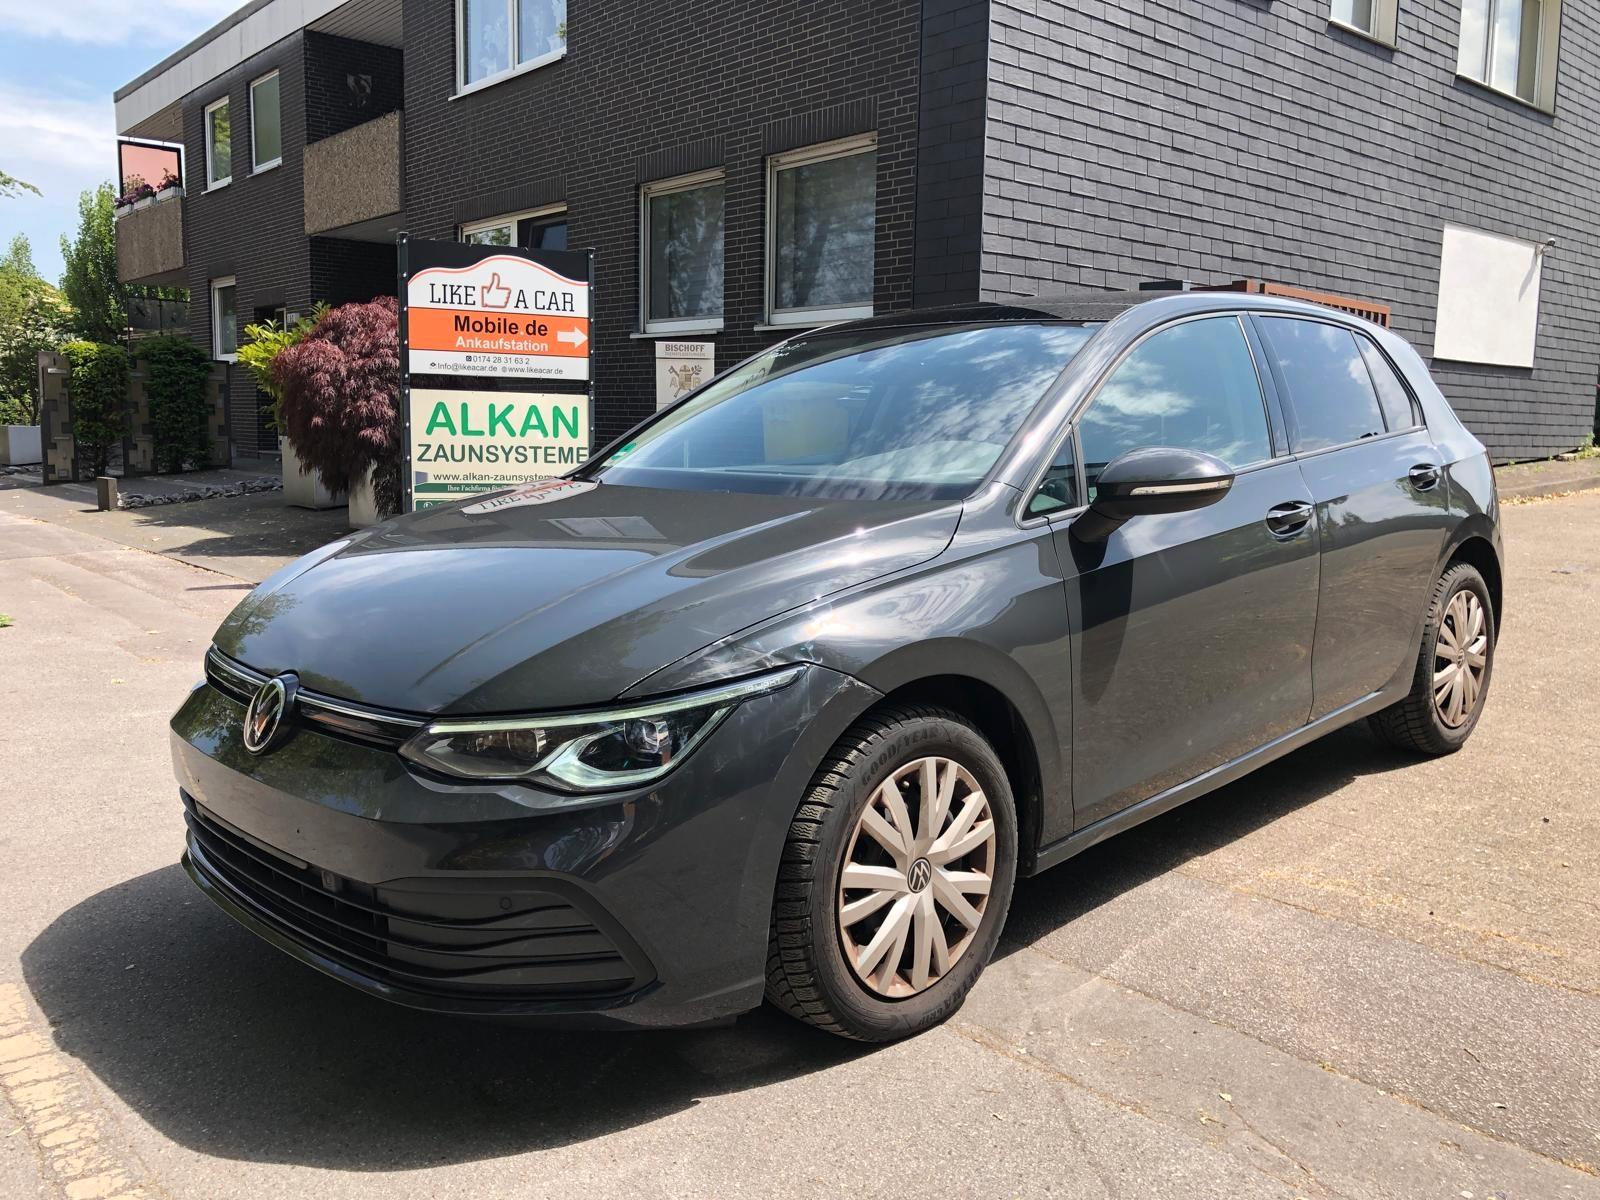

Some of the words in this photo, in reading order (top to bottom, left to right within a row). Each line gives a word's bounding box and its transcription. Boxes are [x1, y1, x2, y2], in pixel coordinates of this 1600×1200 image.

[429, 283, 476, 306] LIKE
[514, 289, 529, 309] A
[534, 290, 575, 312] CAR
[454, 315, 548, 336] Mobile.de
[455, 336, 549, 352] Ankaufstation
[665, 343, 705, 352] BISCHOFF
[473, 355, 491, 363] 0174
[493, 356, 502, 364] 28
[508, 365, 563, 375] www.likeacar.de
[425, 401, 579, 439] ALKAN
[417, 443, 588, 464] ZAUNSYSTEME
[447, 484, 460, 492] Ihre
